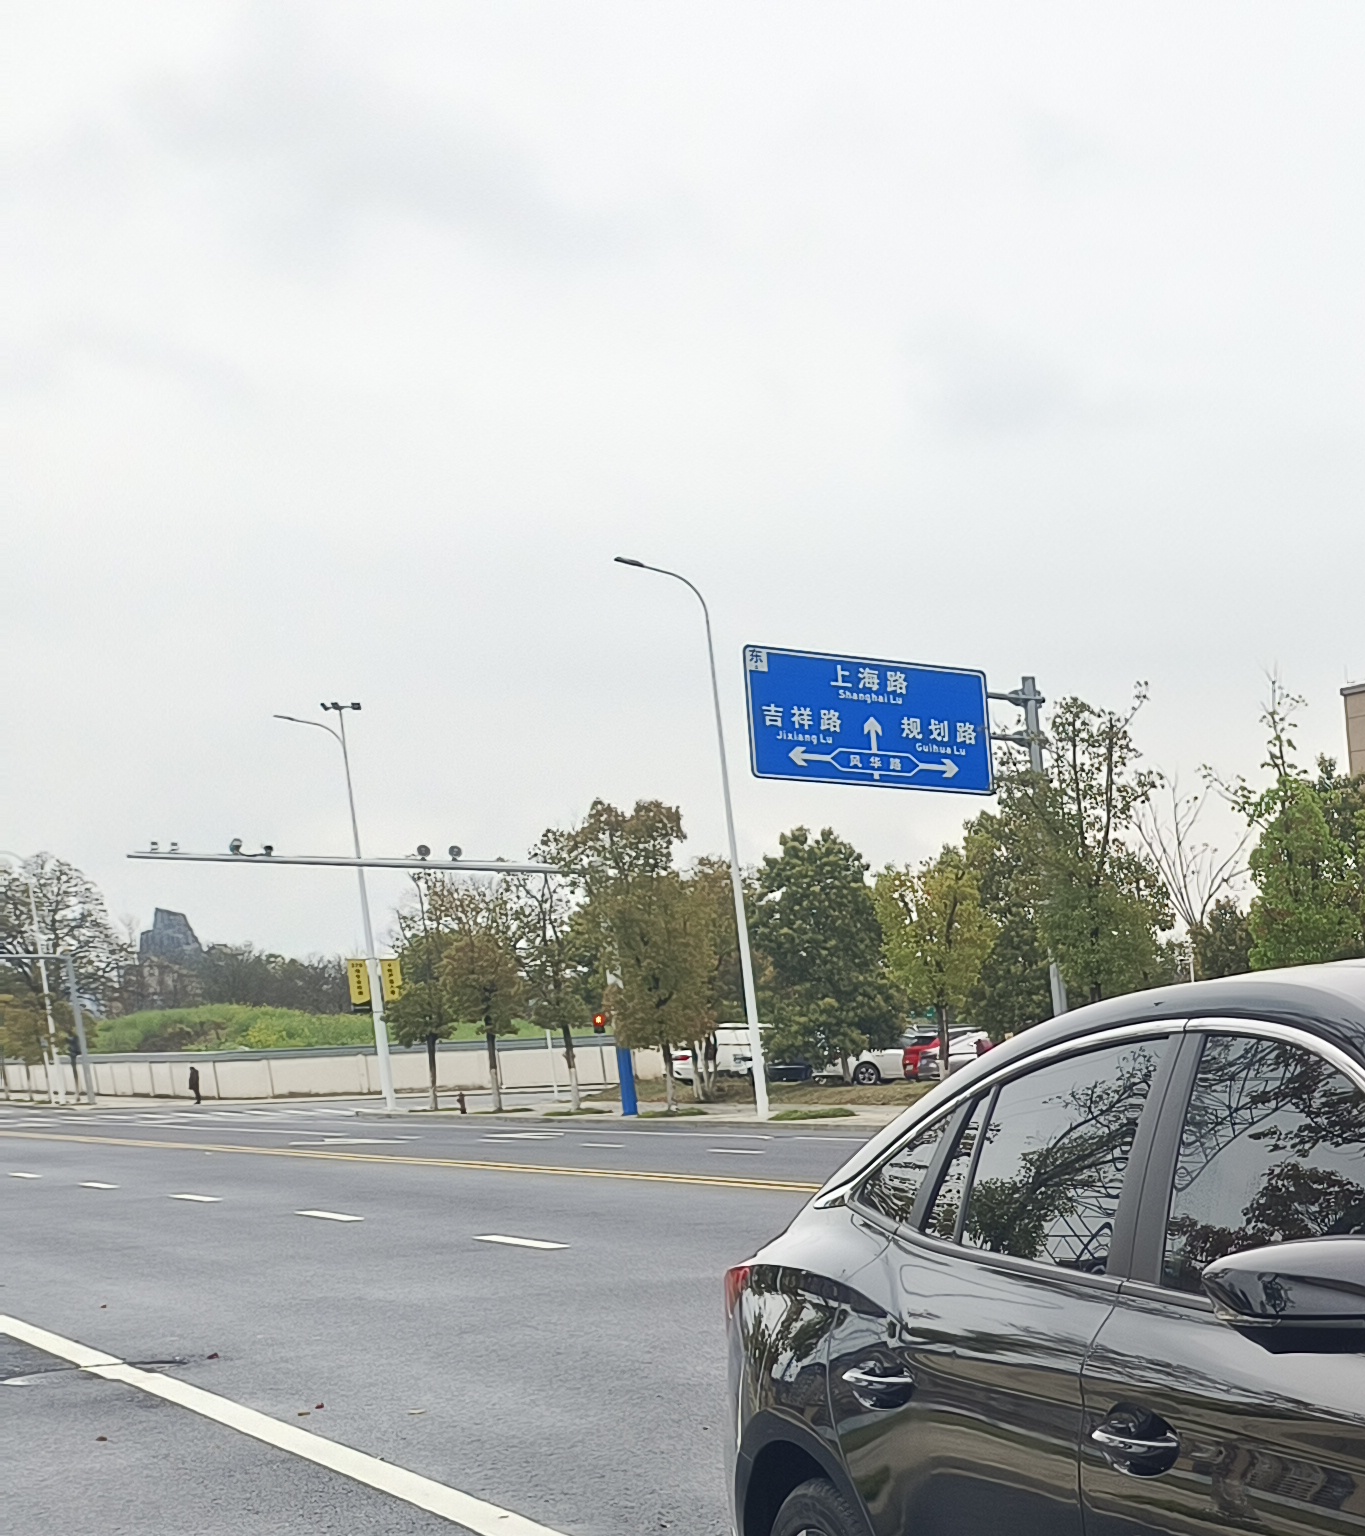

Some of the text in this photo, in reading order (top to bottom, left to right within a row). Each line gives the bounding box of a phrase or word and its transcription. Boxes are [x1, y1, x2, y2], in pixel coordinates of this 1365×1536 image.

[749, 649, 764, 664] 东
[830, 665, 908, 695] 上海路
[838, 689, 903, 705] Shanghai Lu
[761, 703, 842, 733] 吉祥路
[776, 730, 834, 745] Jixiang Lu
[900, 716, 977, 745] 规划路
[915, 742, 966, 756] Guihua Lu
[849, 755, 902, 771] 风华路
